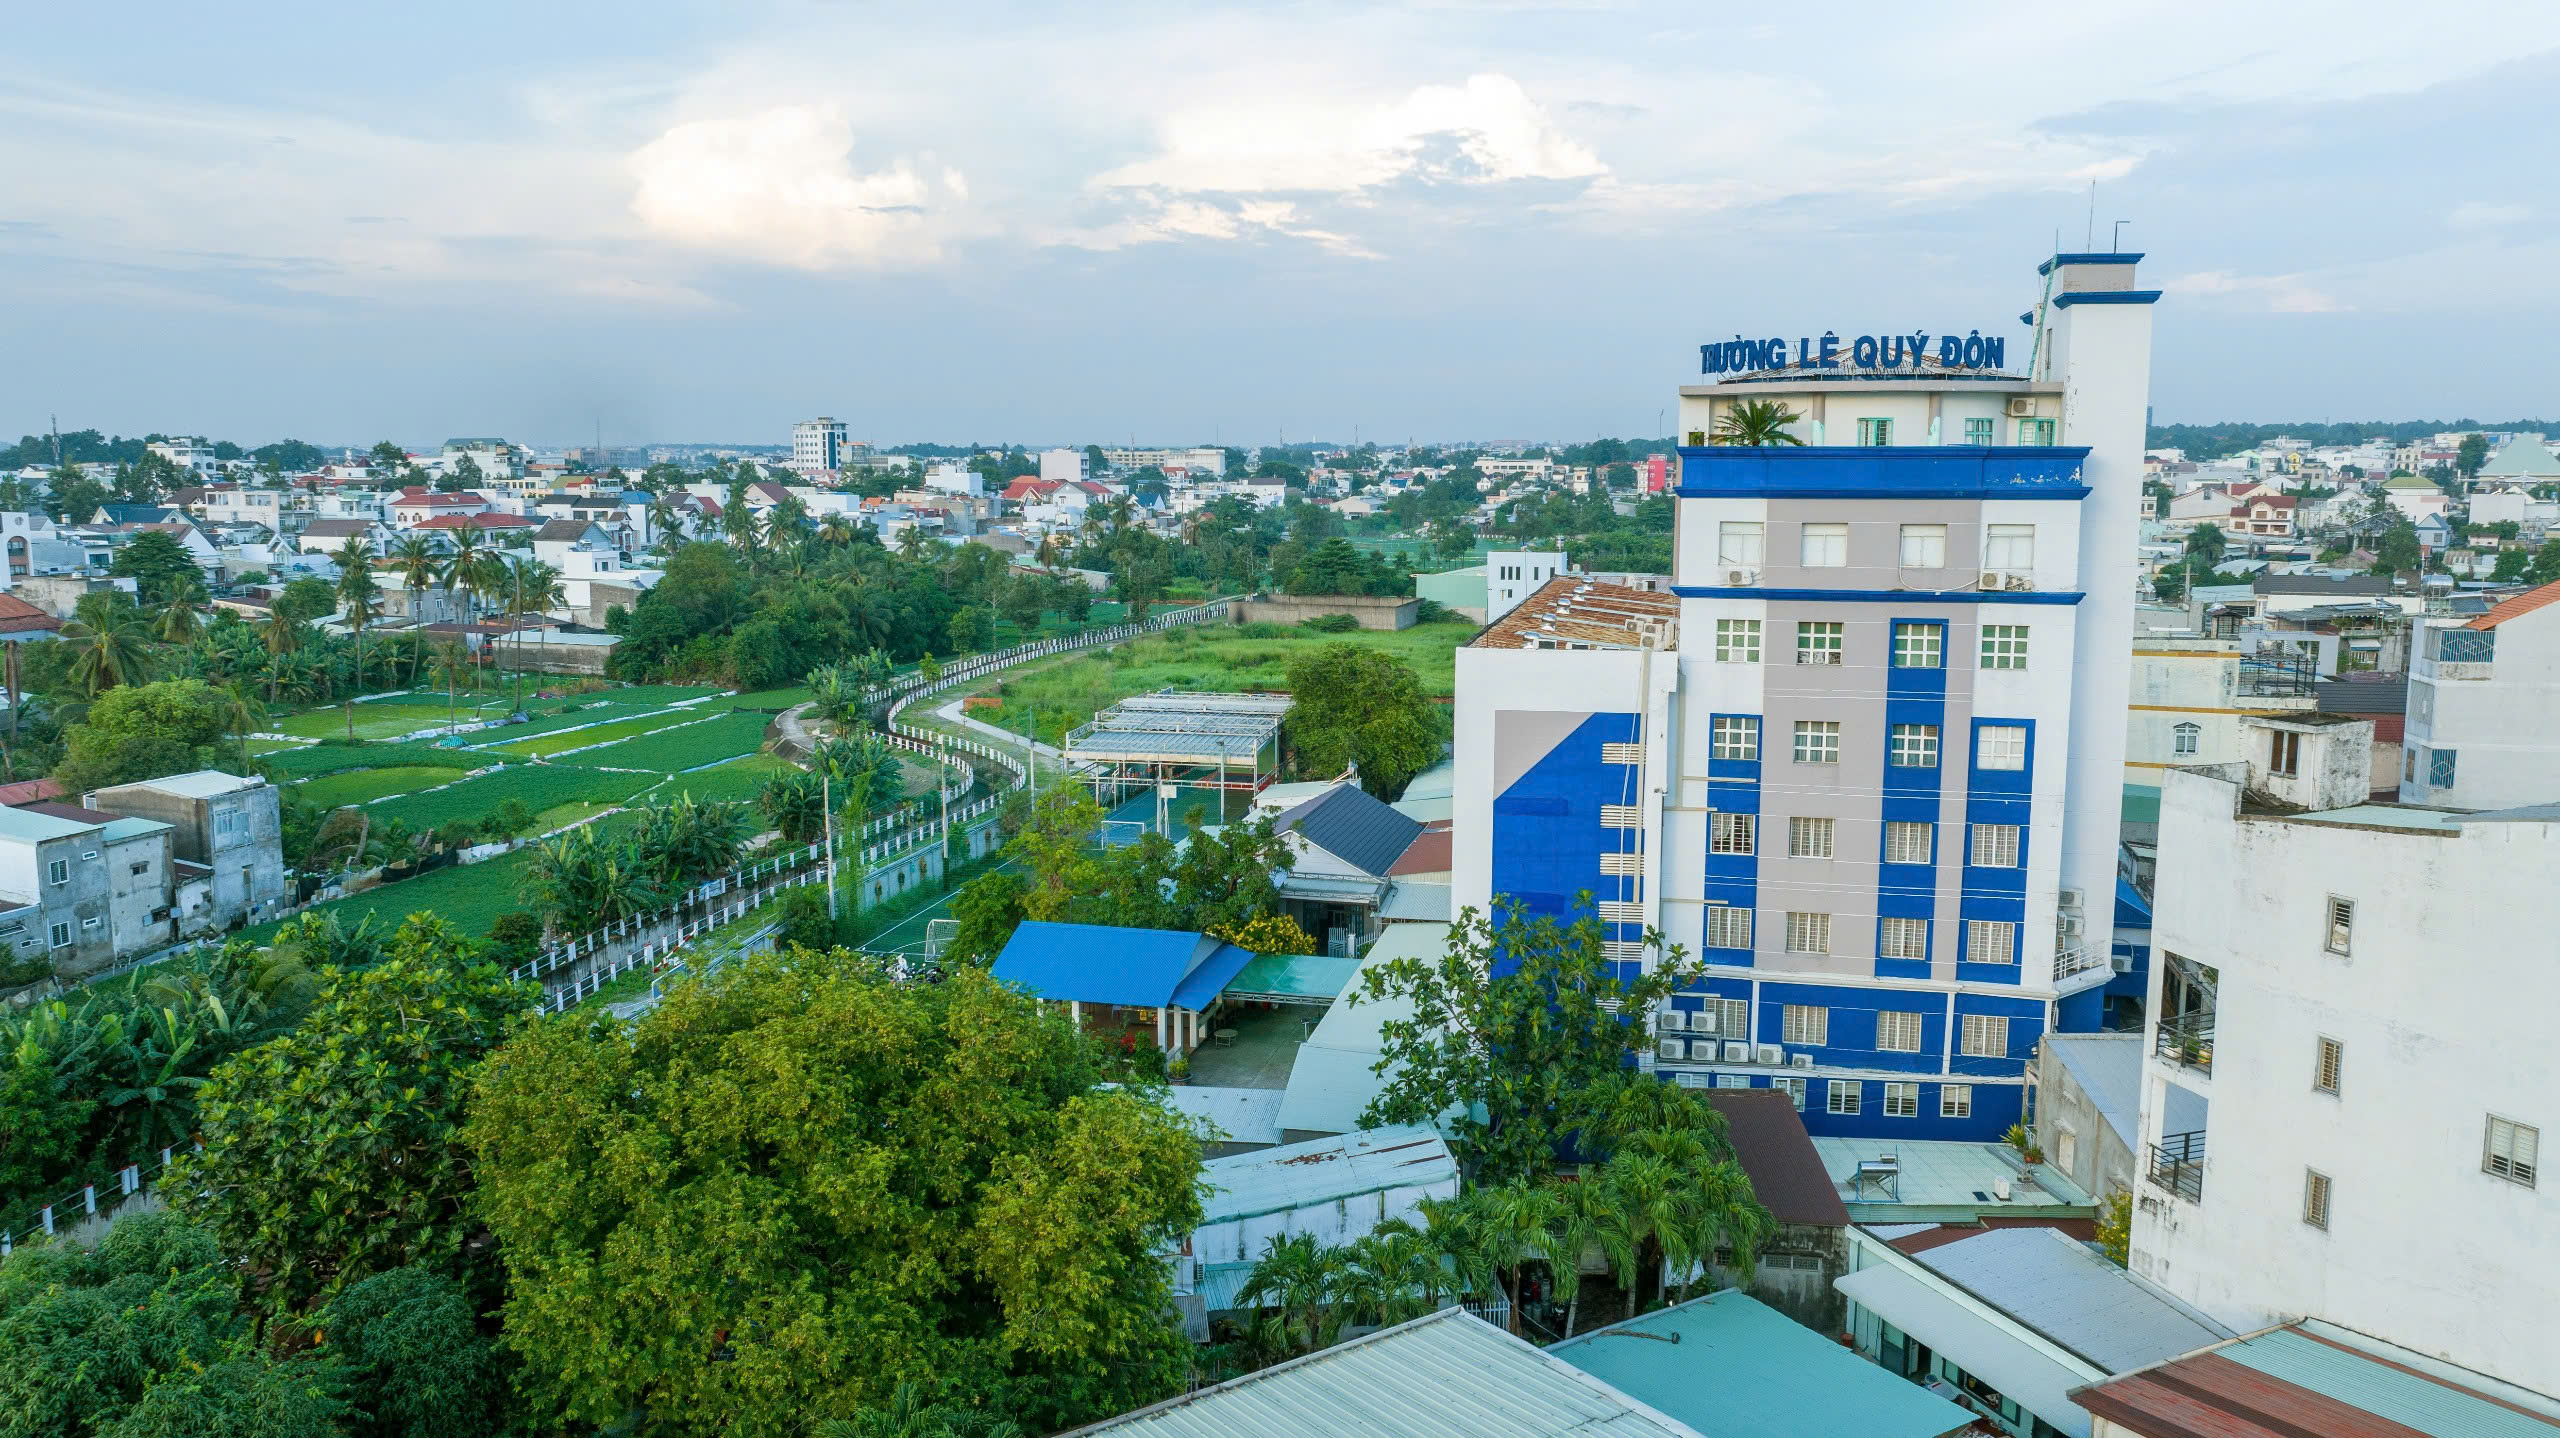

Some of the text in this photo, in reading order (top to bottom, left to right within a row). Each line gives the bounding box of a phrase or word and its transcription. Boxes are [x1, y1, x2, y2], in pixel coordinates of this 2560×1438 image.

[1801, 331, 1840, 368] LÊ
[1854, 330, 1930, 369] QUÝ
[1940, 330, 2004, 369] ĐÔN
